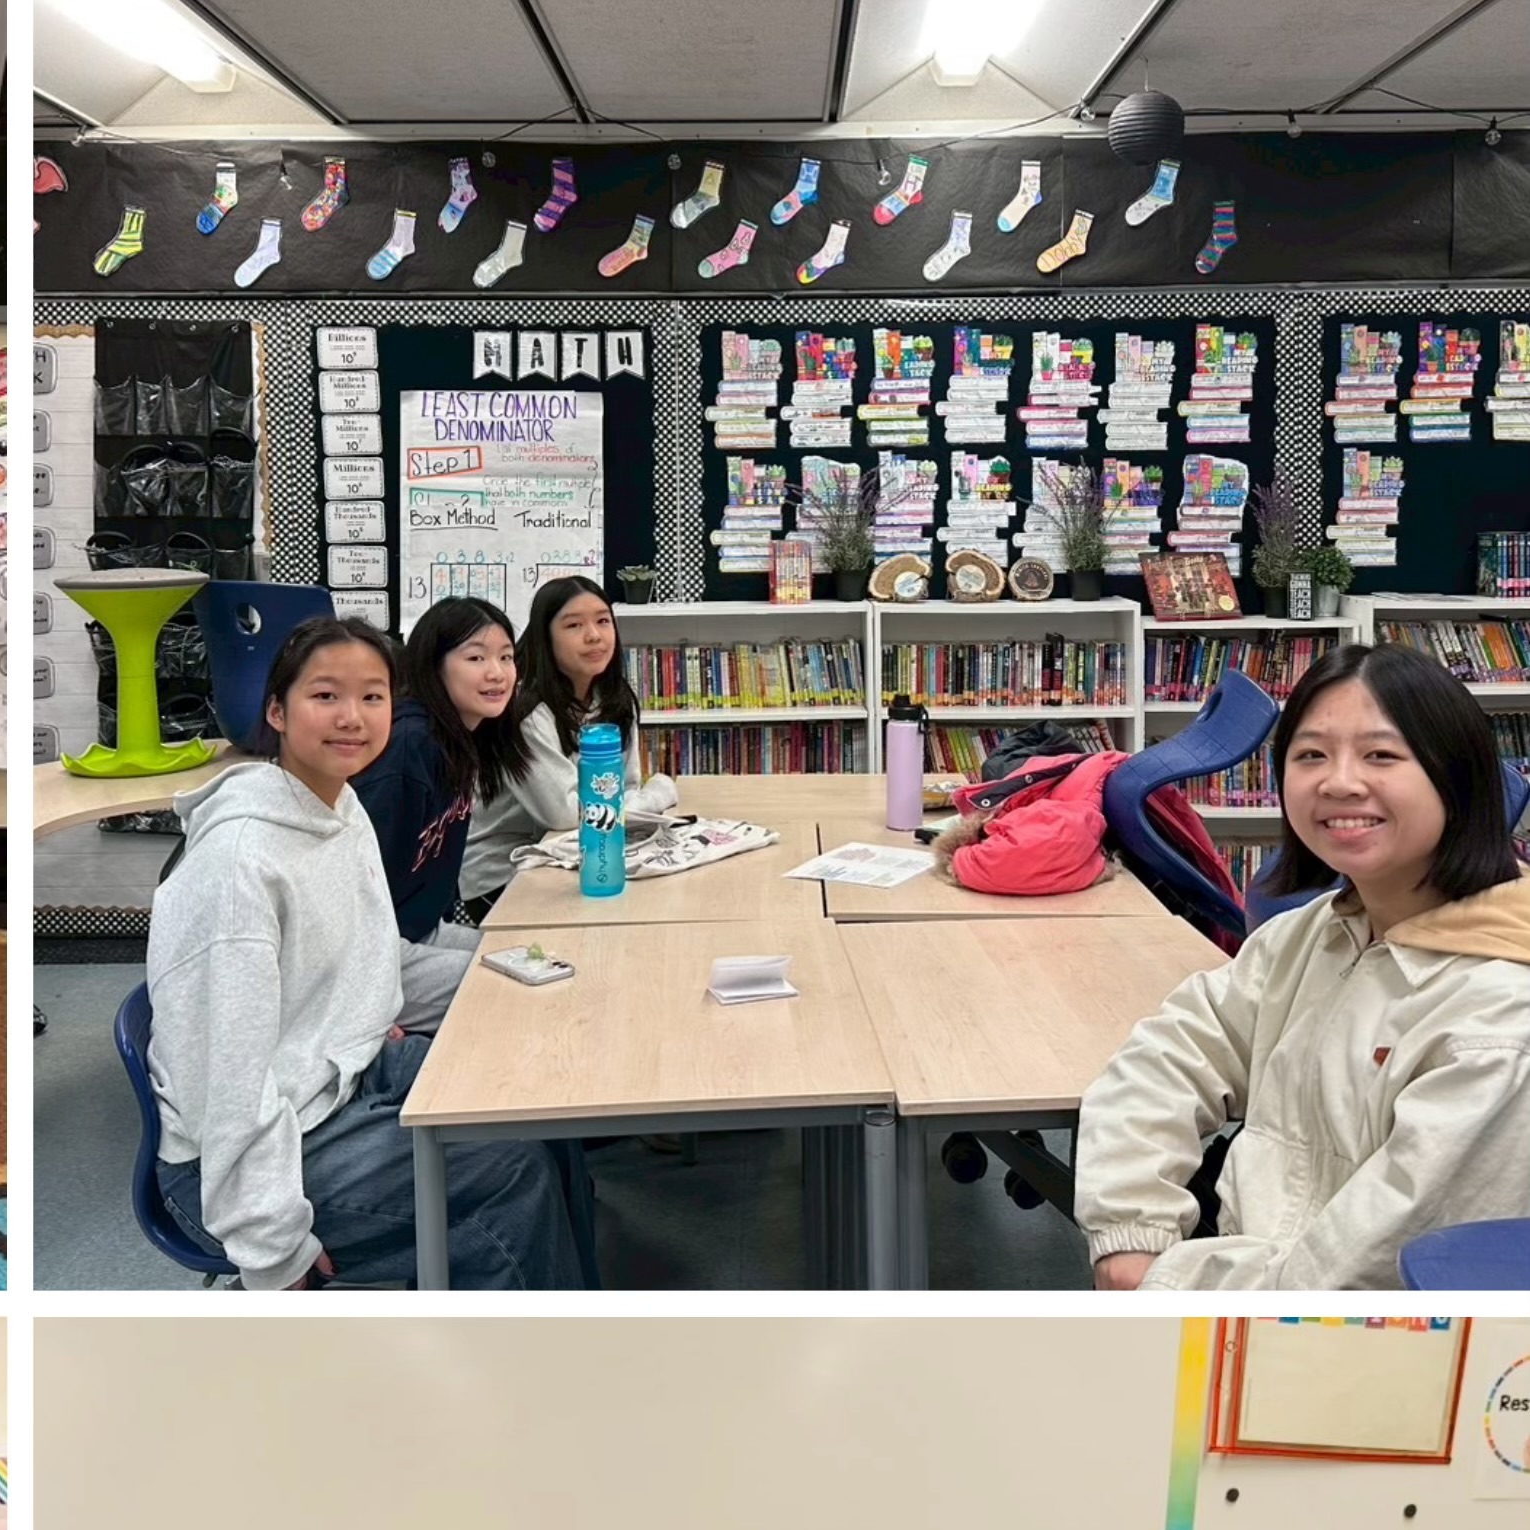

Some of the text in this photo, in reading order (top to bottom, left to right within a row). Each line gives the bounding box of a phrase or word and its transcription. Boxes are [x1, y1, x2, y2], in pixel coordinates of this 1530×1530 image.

[421, 391, 577, 419] LEAST COMMON
[434, 418, 556, 442] DENOMINATOR
[409, 449, 473, 477] Step 1
[504, 488, 527, 499] both
[528, 489, 574, 500] numbers
[410, 508, 592, 529] Box Method Traditional
[408, 576, 427, 600] 13
